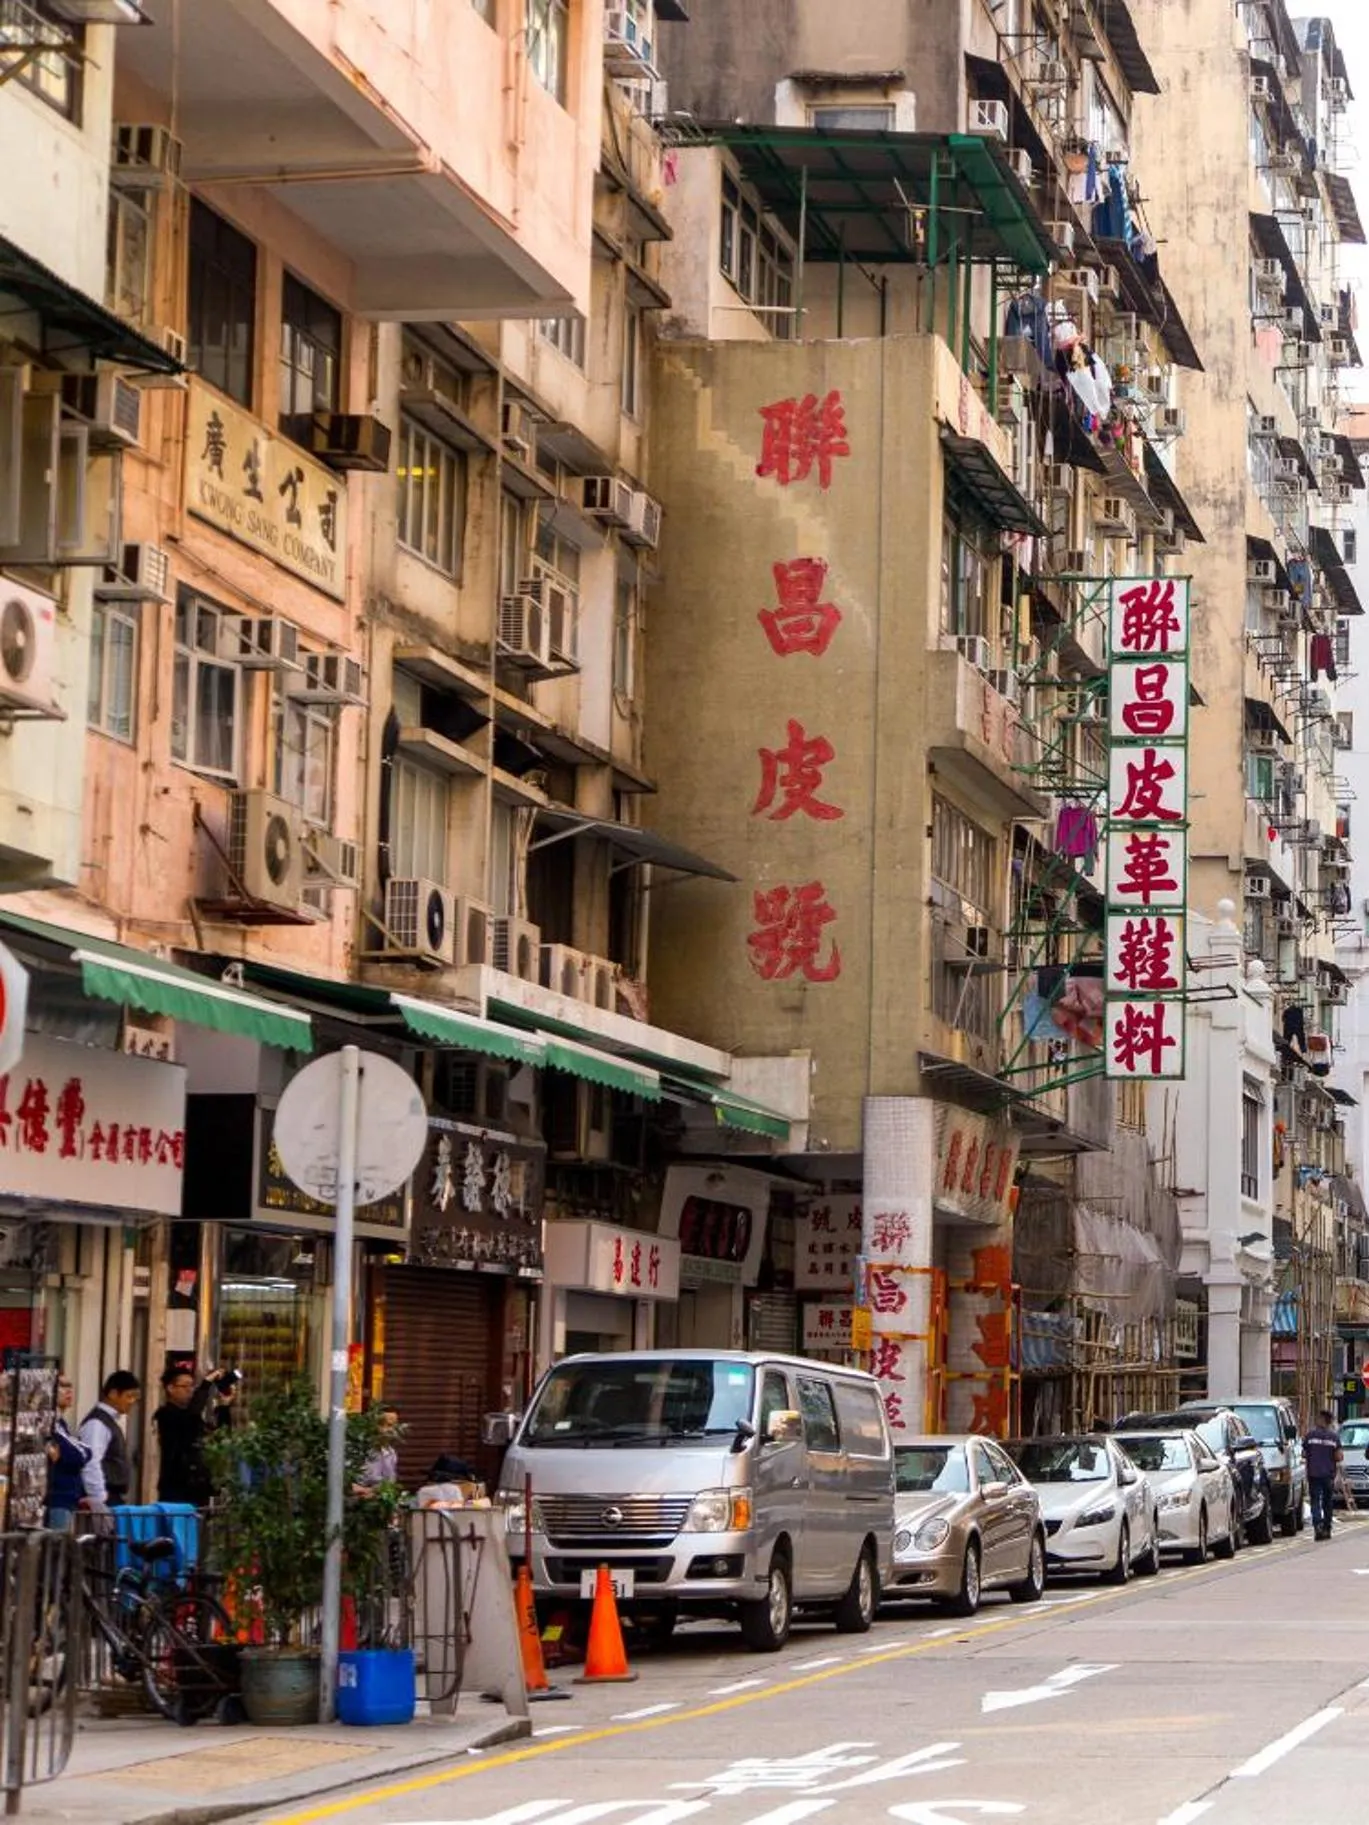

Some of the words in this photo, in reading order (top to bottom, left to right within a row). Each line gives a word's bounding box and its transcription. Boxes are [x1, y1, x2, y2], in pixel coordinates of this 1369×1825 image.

[201, 410, 338, 552] 廣生公司
[201, 480, 242, 526] KWONG
[247, 509, 279, 547] SANG
[283, 534, 336, 583] COMPANY
[747, 389, 850, 983] 聯昌皮號
[1112, 579, 1182, 1075] 聯昌皮革鞋料
